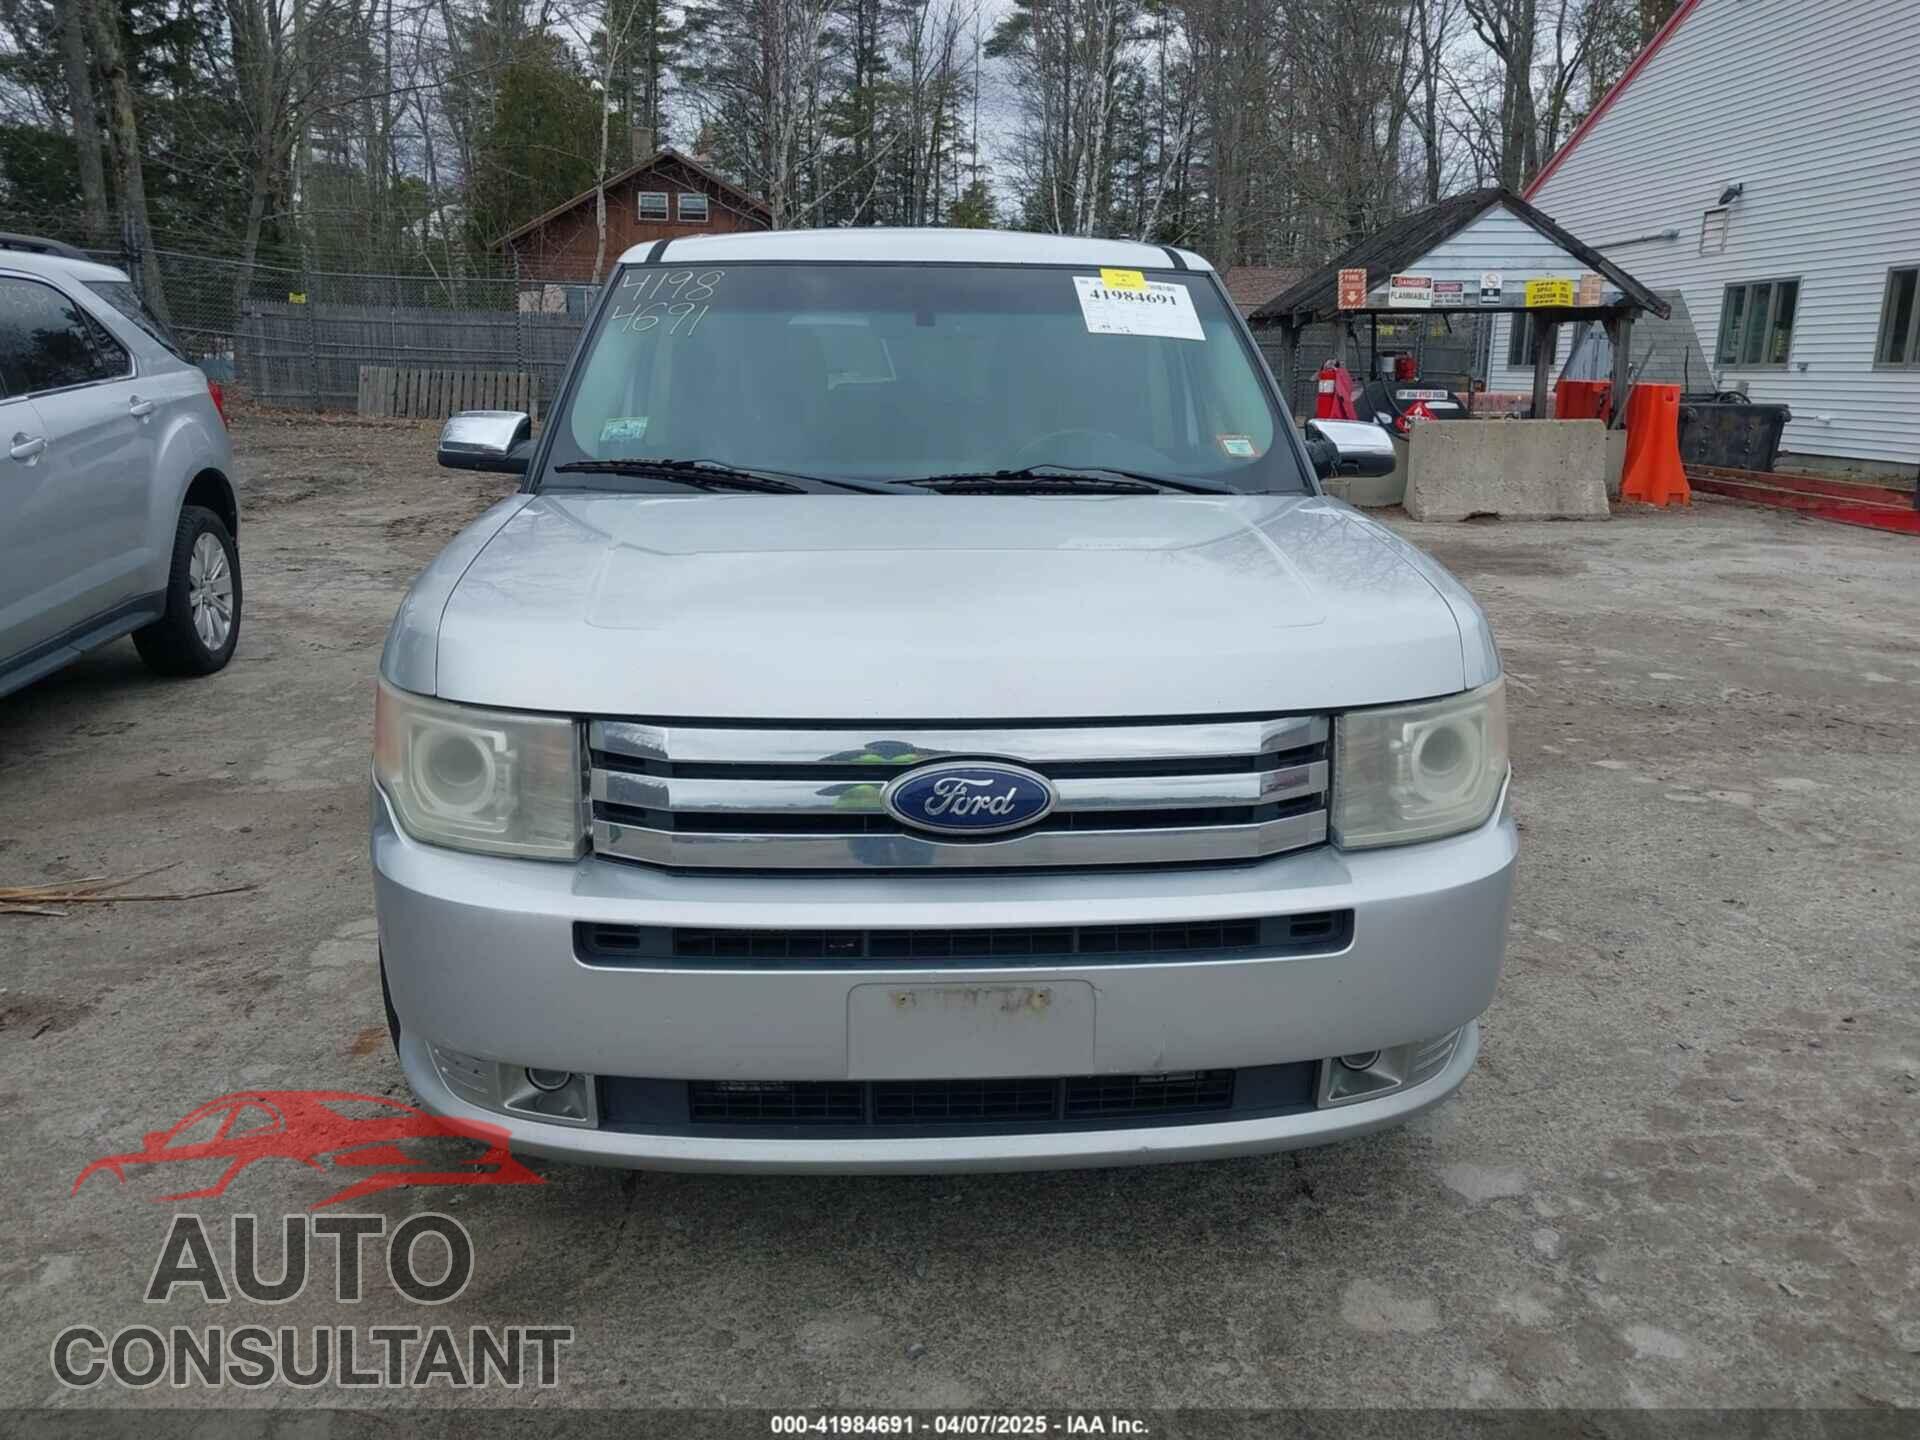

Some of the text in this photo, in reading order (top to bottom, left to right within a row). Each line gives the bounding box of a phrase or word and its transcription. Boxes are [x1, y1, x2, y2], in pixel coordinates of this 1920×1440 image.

[622, 270, 725, 300] 4198
[1398, 278, 1426, 286] DANGER
[1090, 289, 1177, 306] 41984691
[1391, 290, 1431, 300] FLAMMABLE
[611, 302, 709, 336] 4691
[924, 777, 1017, 816] Ford
